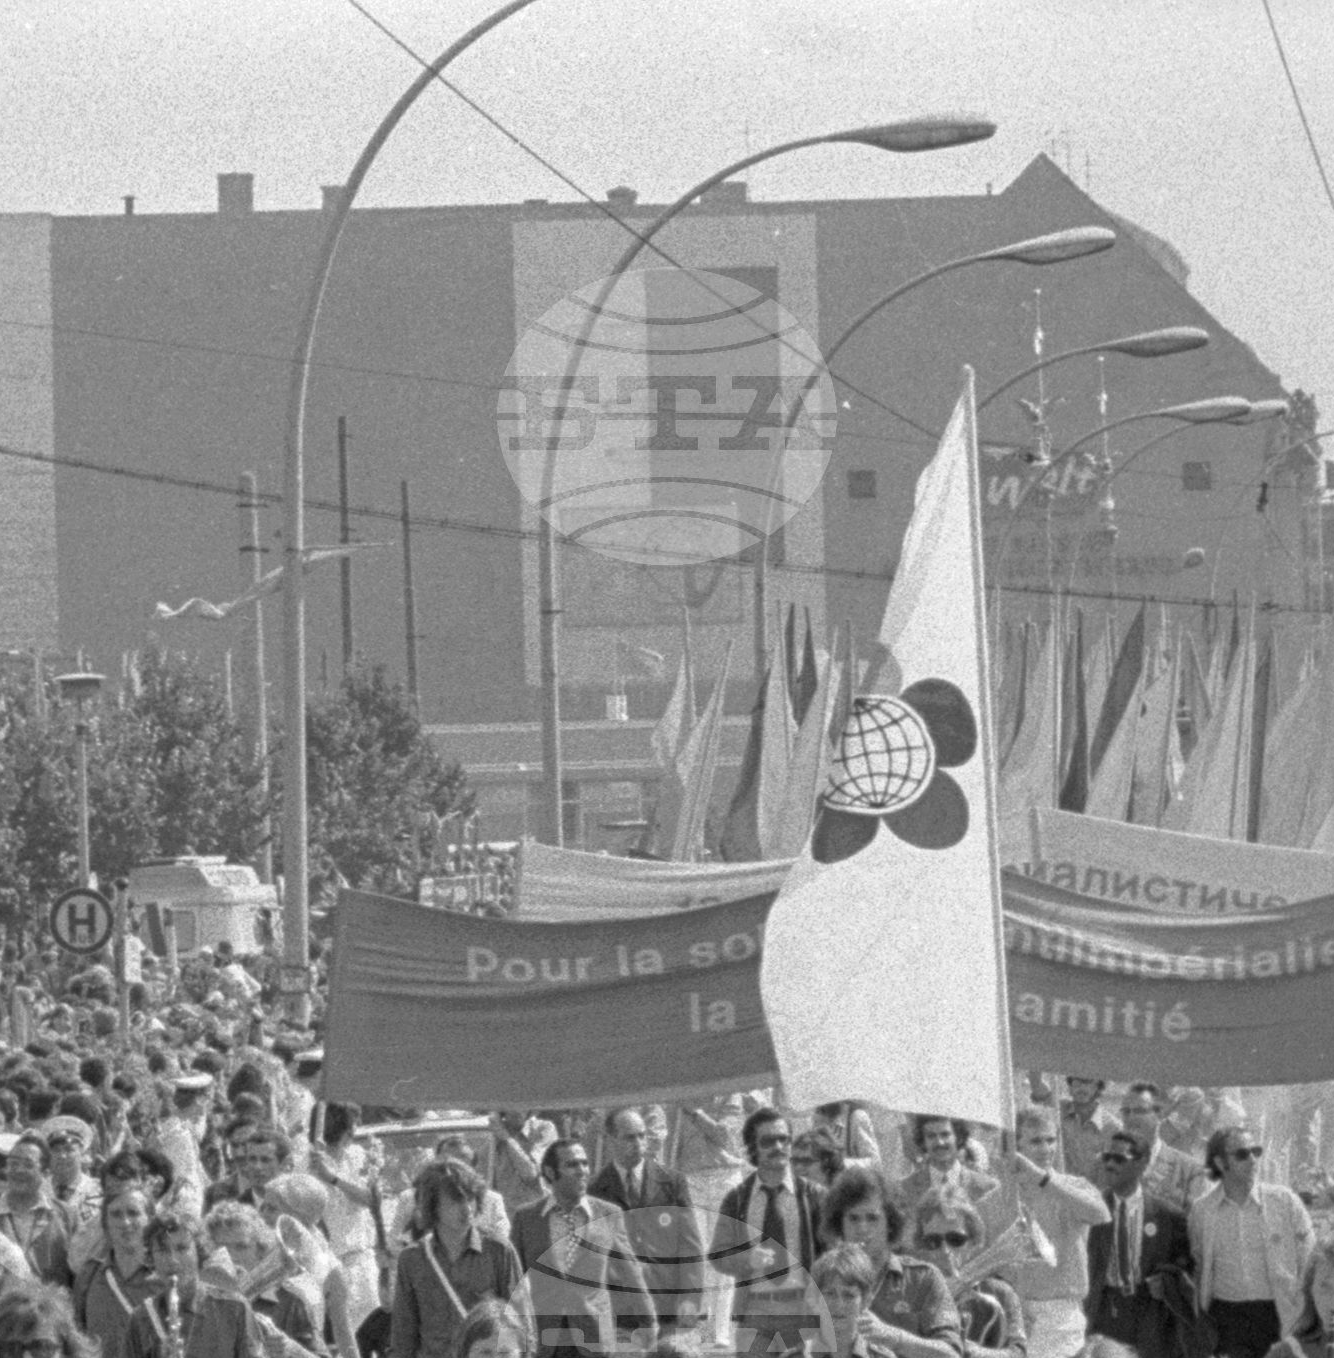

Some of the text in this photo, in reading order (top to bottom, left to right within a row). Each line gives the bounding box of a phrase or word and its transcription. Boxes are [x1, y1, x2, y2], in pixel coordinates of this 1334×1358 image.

[67, 902, 96, 944] H
[467, 945, 593, 982] Pour
[617, 944, 665, 977] la
[689, 991, 737, 1033] la
